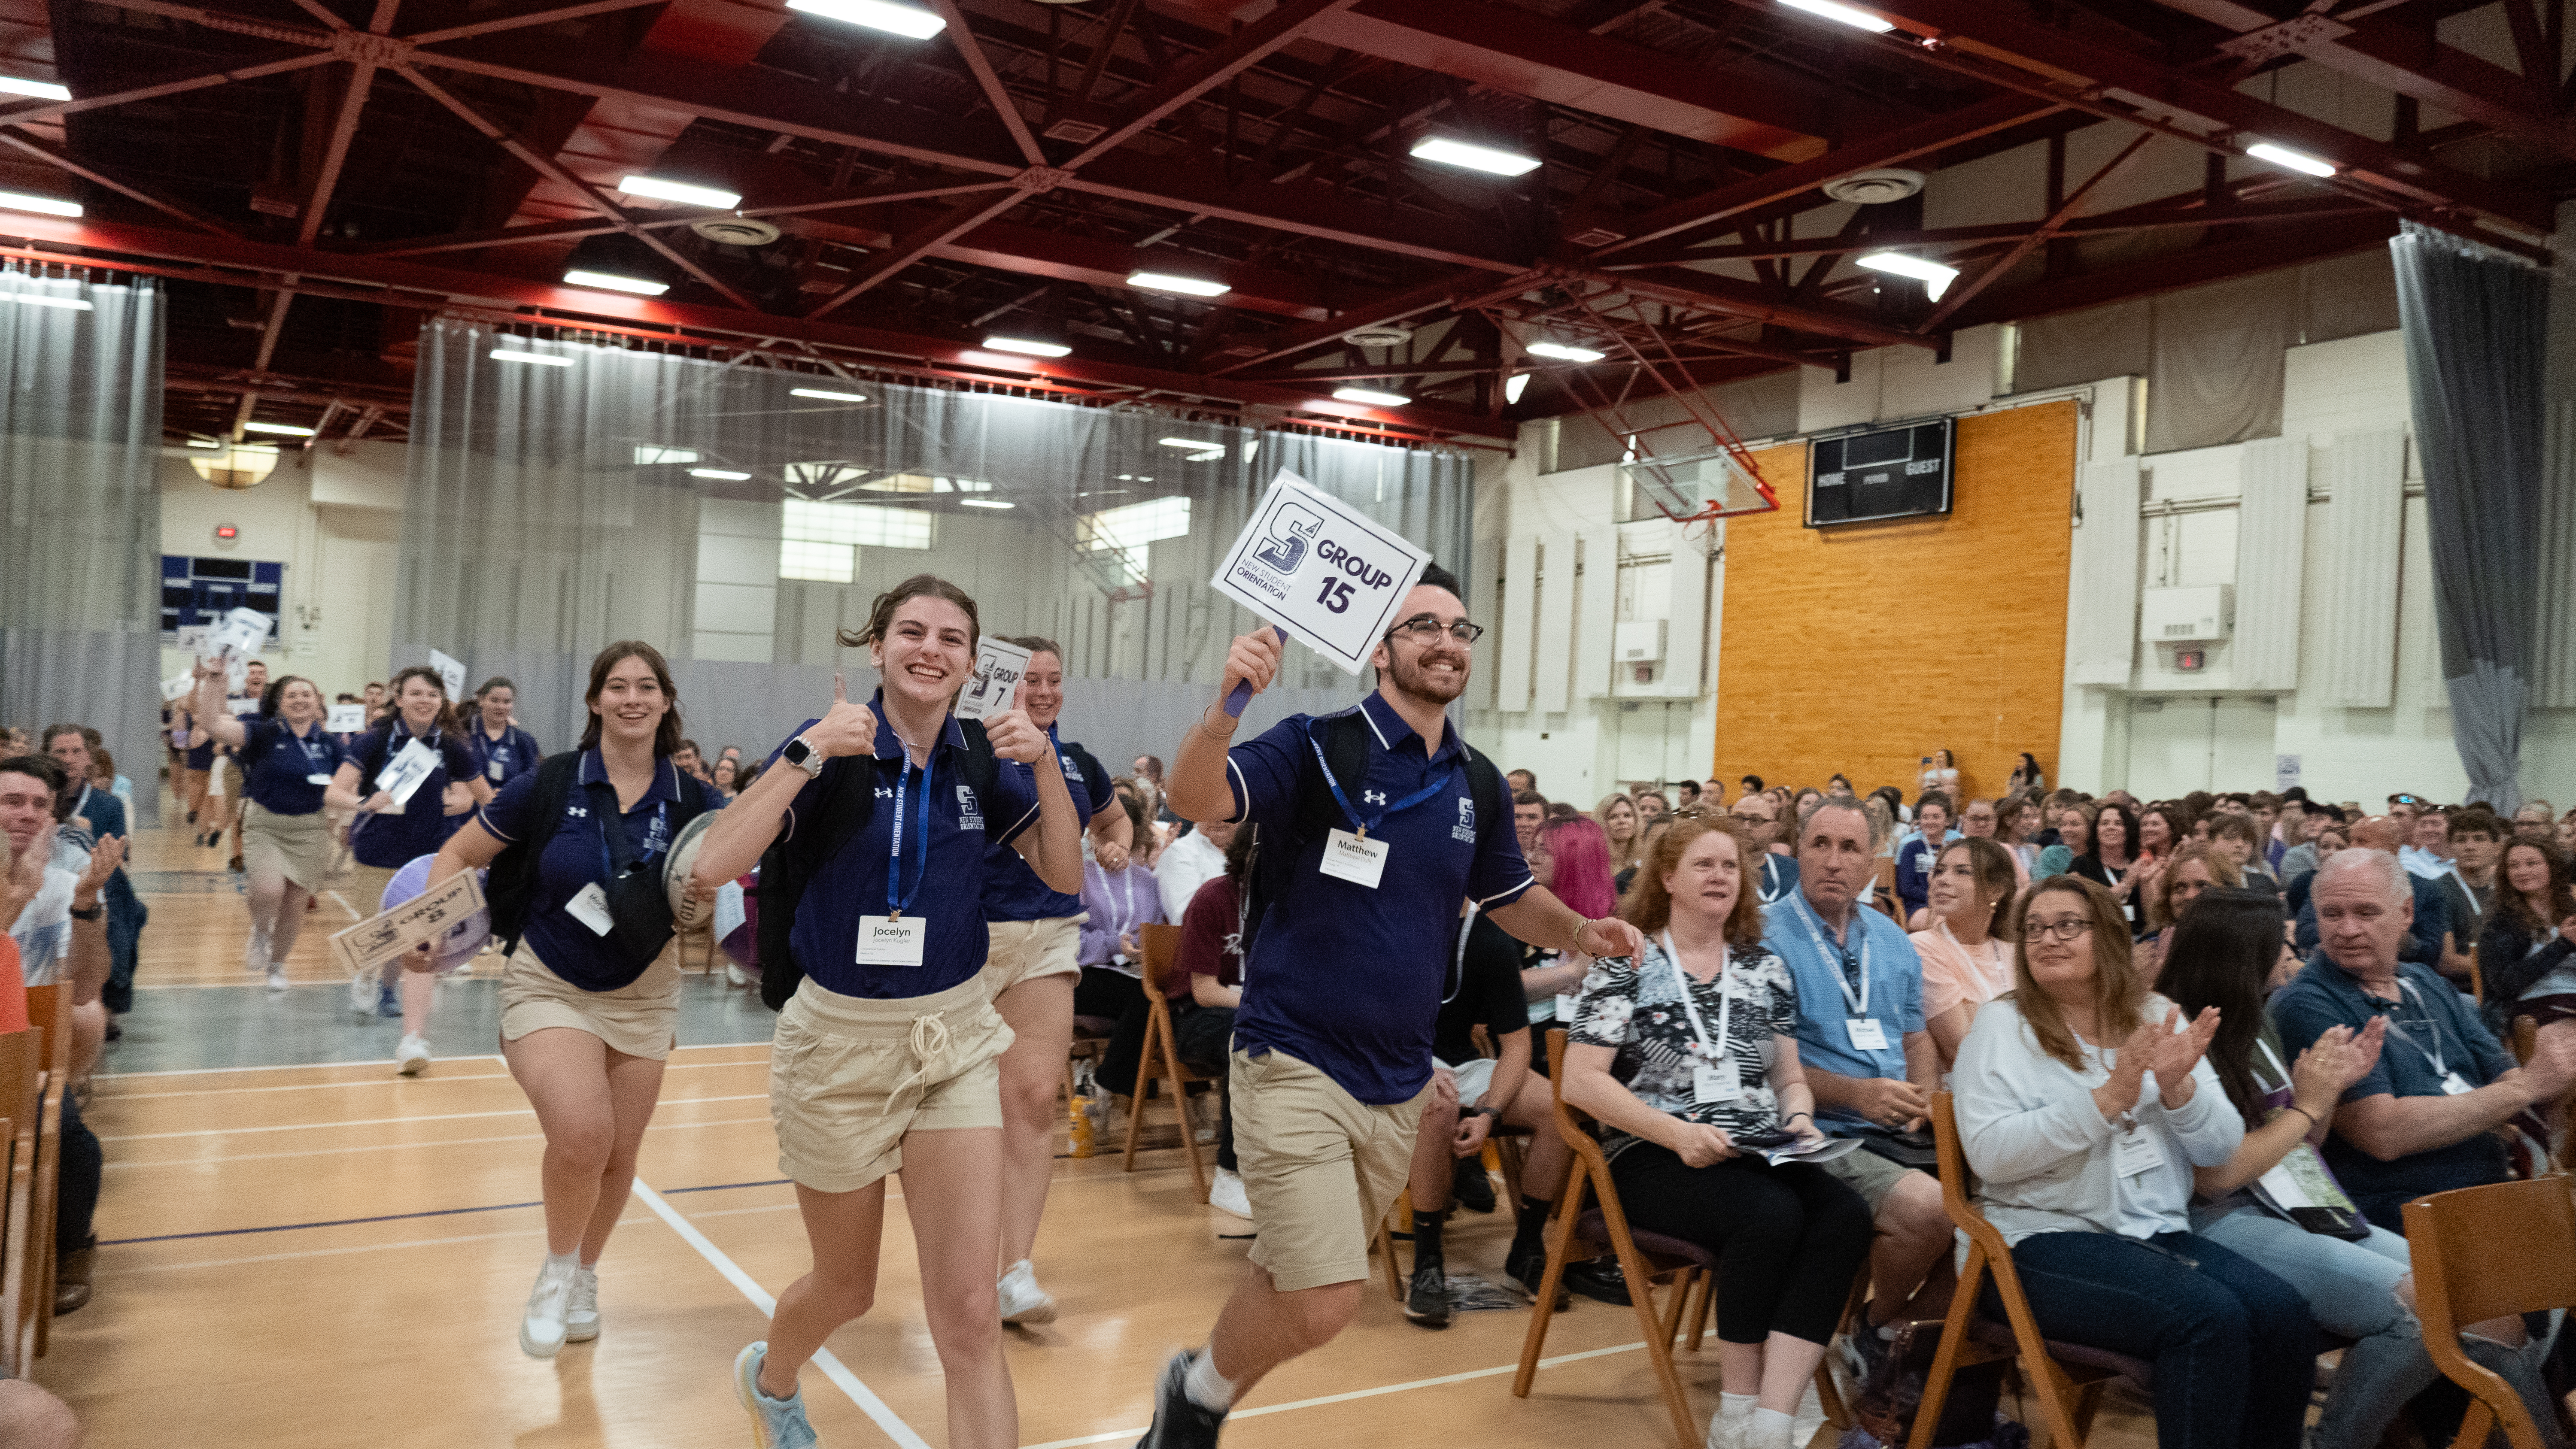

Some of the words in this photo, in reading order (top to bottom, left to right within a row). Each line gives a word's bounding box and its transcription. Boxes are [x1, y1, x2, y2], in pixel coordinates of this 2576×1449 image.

[1241, 558, 1260, 573] NEW
[1260, 569, 1291, 591] STUDENT
[1317, 540, 1392, 589] GROUP
[1237, 567, 1286, 600] ORIENTATION
[1317, 576, 1356, 613] 15
[993, 667, 1019, 684] GROUP
[993, 687, 1006, 706] 7
[1318, 756, 1337, 787] ORIENTATION
[895, 799, 904, 821] STUDENT
[891, 822, 902, 857] ORIENTATION
[1337, 840, 1378, 858] Matthew
[399, 887, 462, 925] GROUP
[873, 926, 911, 938] Jocelyn
